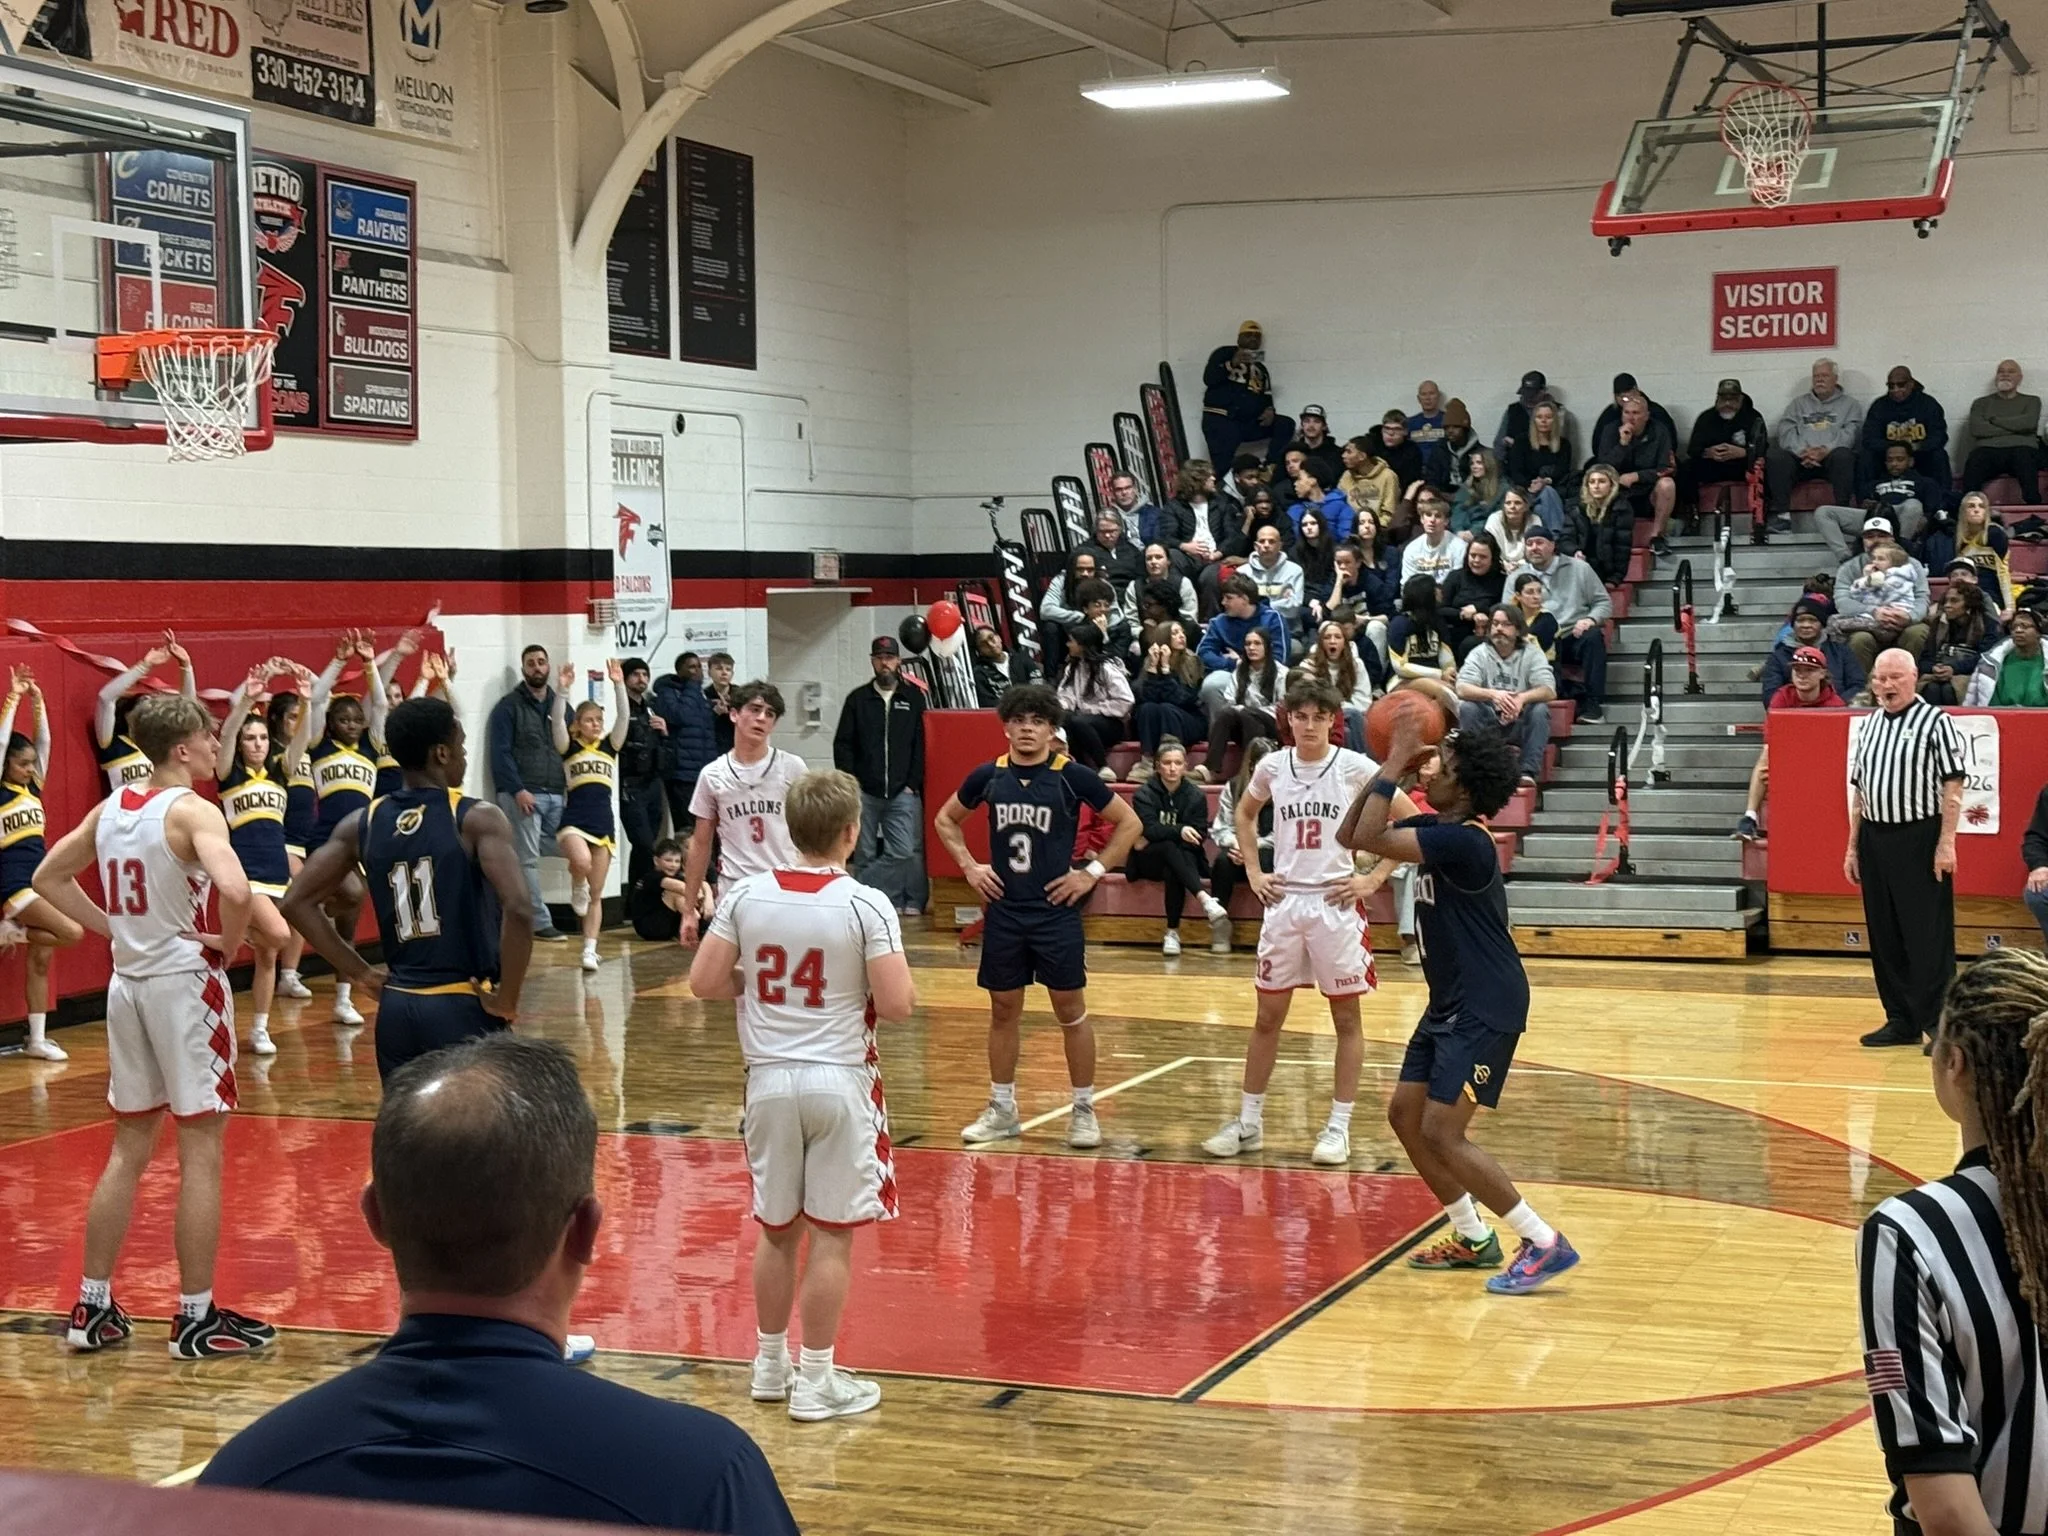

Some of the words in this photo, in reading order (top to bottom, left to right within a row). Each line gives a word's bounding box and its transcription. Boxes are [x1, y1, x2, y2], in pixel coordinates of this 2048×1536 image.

[150, 0, 240, 58] RED
[256, 53, 366, 110] 330-552-3154
[394, 74, 454, 107] MELLION
[147, 179, 211, 208] COMETS
[357, 218, 407, 243] RAVENS
[341, 275, 408, 301] PANTHERS
[1724, 281, 1824, 309] VISITOR
[144, 310, 214, 330] FLCONS
[1719, 312, 1828, 339] SECTION
[343, 335, 409, 360] BULLDOGS
[343, 395, 409, 418] SPARTANS
[615, 620, 647, 648] 024
[121, 763, 153, 784] ROCK
[320, 764, 374, 787] ROCKETS
[570, 760, 613, 779] ROCKETS
[1964, 774, 1993, 791] 026
[233, 791, 287, 815] ROCKETS
[726, 800, 782, 820] FALCONS
[1280, 802, 1340, 821] FALCONS
[749, 816, 765, 844] 3
[994, 803, 1052, 834] BORO
[1295, 819, 1322, 850] 12
[1008, 832, 1032, 873] 3
[107, 857, 149, 917] 13
[387, 855, 441, 943] 11
[755, 944, 828, 1008] 24
[1334, 974, 1361, 989] FIELD
